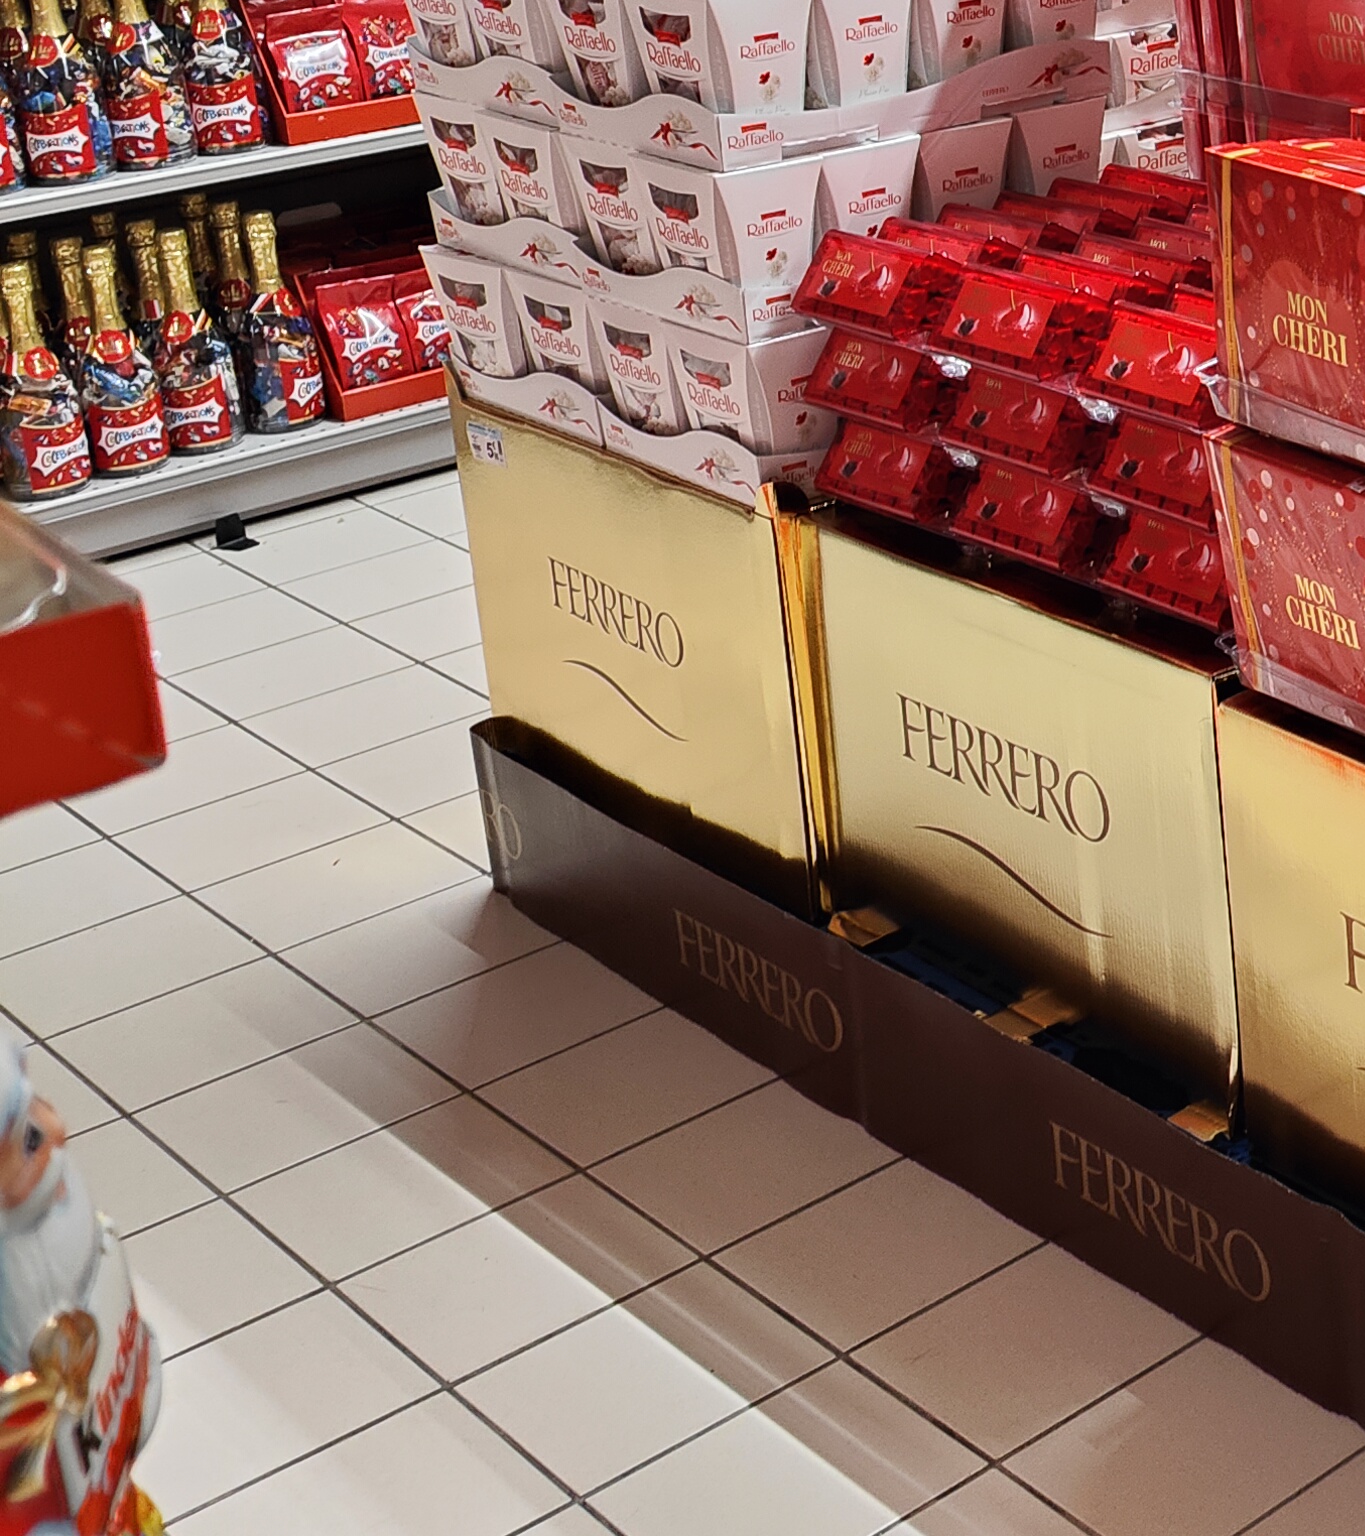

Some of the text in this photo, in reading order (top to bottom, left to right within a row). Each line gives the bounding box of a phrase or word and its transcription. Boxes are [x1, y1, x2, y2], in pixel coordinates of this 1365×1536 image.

[474, 7, 521, 37] Raffaello
[945, 5, 996, 24] Raffaello
[1329, 12, 1365, 36] MON
[563, 25, 616, 53] Raffaello
[844, 20, 898, 42] Raffaello
[645, 42, 702, 73] Raffaello
[739, 37, 796, 60] Raffaello
[726, 127, 785, 150] Raffaello
[437, 147, 487, 176] Raffaello
[1042, 146, 1090, 170] Raffaello
[502, 170, 548, 201] Raffaello
[941, 169, 994, 193] Raffaello
[587, 192, 639, 223] Raffaello
[848, 191, 902, 215] Raffaello
[656, 216, 709, 250] Raffaello
[746, 211, 803, 237] Raffaello
[446, 303, 496, 335] Raffaello
[1286, 290, 1329, 325] MON
[531, 326, 581, 358] Raffaello
[1272, 313, 1348, 368] CHÉRI
[610, 354, 661, 387] Raffaello
[688, 381, 741, 417] Raffaello
[1294, 573, 1338, 608] MON
[548, 555, 686, 670] FERRERO
[1284, 595, 1361, 651] CHÉRI
[895, 692, 1113, 844] FERRERO
[674, 908, 845, 1054] FERRERO
[1049, 1120, 1272, 1303] FERRERO
